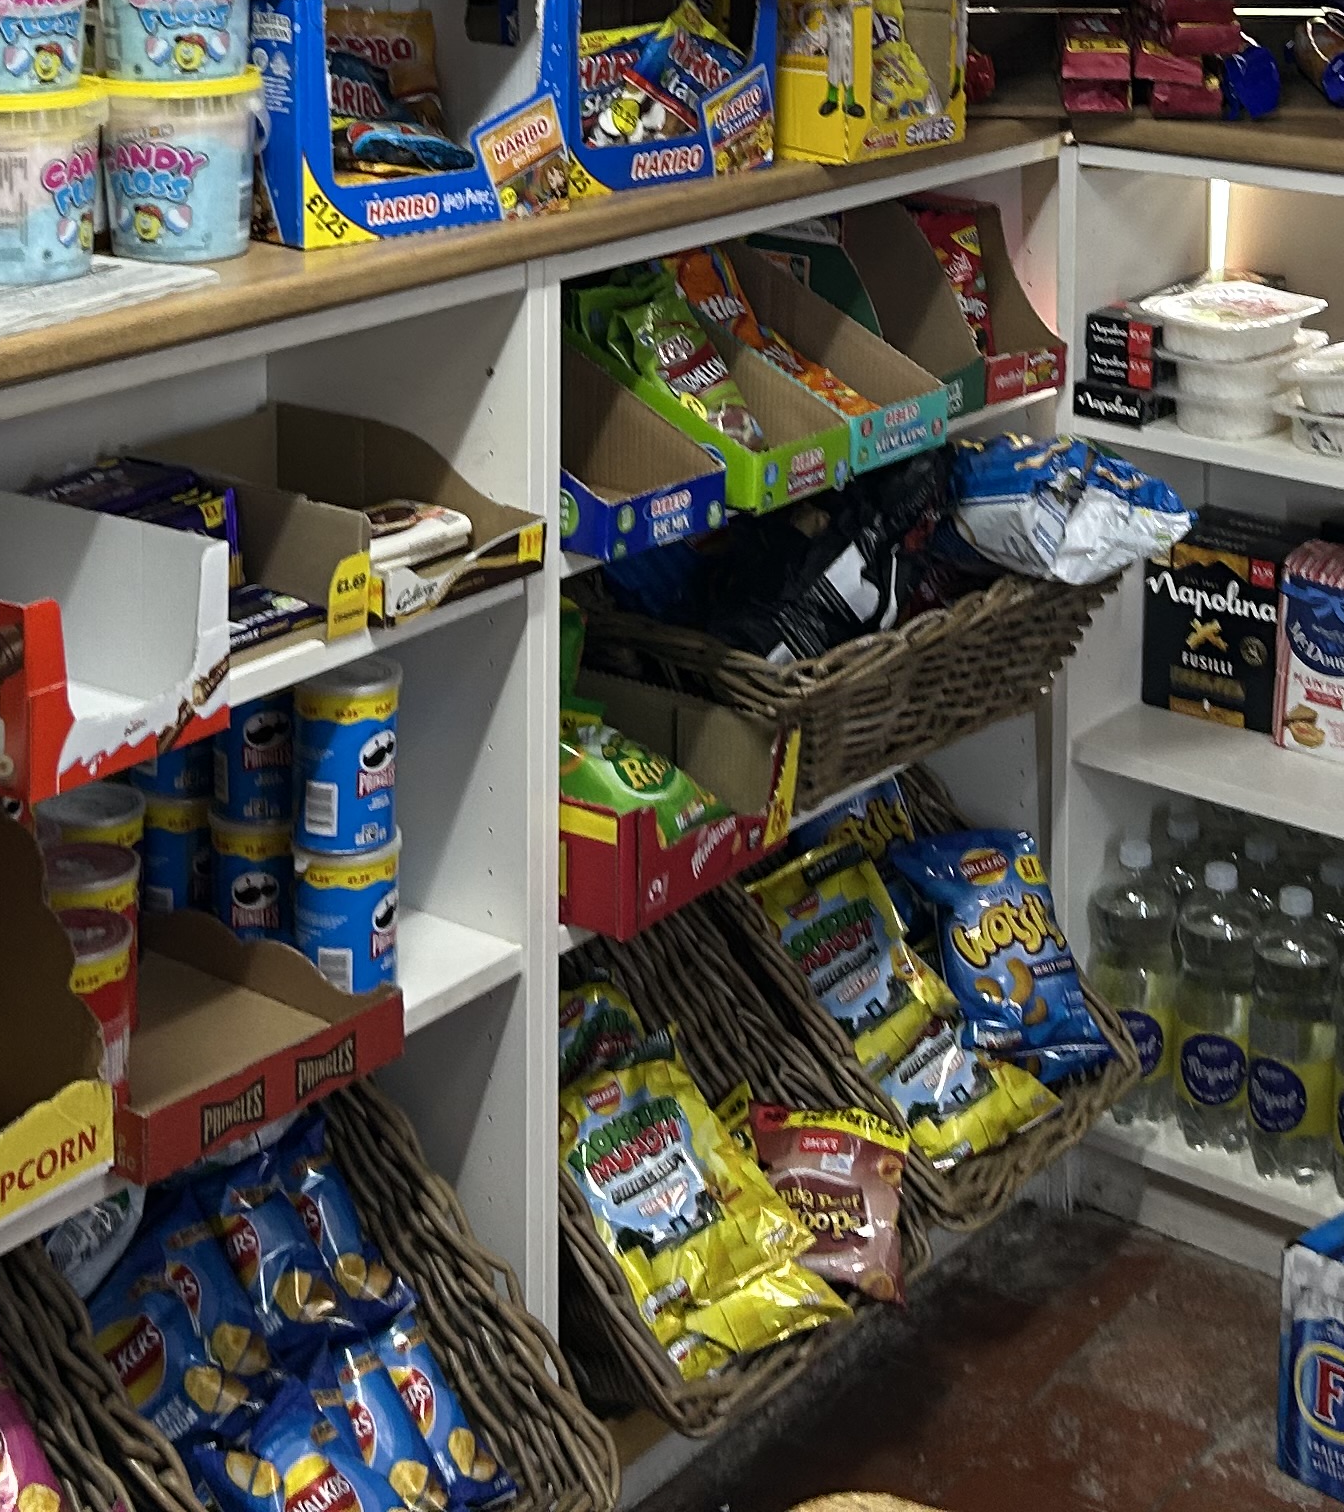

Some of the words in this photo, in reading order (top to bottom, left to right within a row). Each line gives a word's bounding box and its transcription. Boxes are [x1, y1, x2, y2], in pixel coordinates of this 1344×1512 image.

[137, 0, 231, 35] FLOSS
[494, 117, 550, 167] HARIBO
[630, 144, 705, 182] HARIBO
[42, 143, 98, 187] CAN
[55, 172, 96, 217] FLO
[367, 192, 440, 226] HARIBO
[1078, 391, 1140, 419] Napolina
[1146, 571, 1278, 623] Napolina
[1181, 650, 1233, 676] FUSILLI
[298, 1037, 355, 1088] PRINGLES
[202, 1082, 264, 1142] PRINGLES
[589, 1117, 681, 1184] MUNCH
[112, 1325, 159, 1379] LKERS
